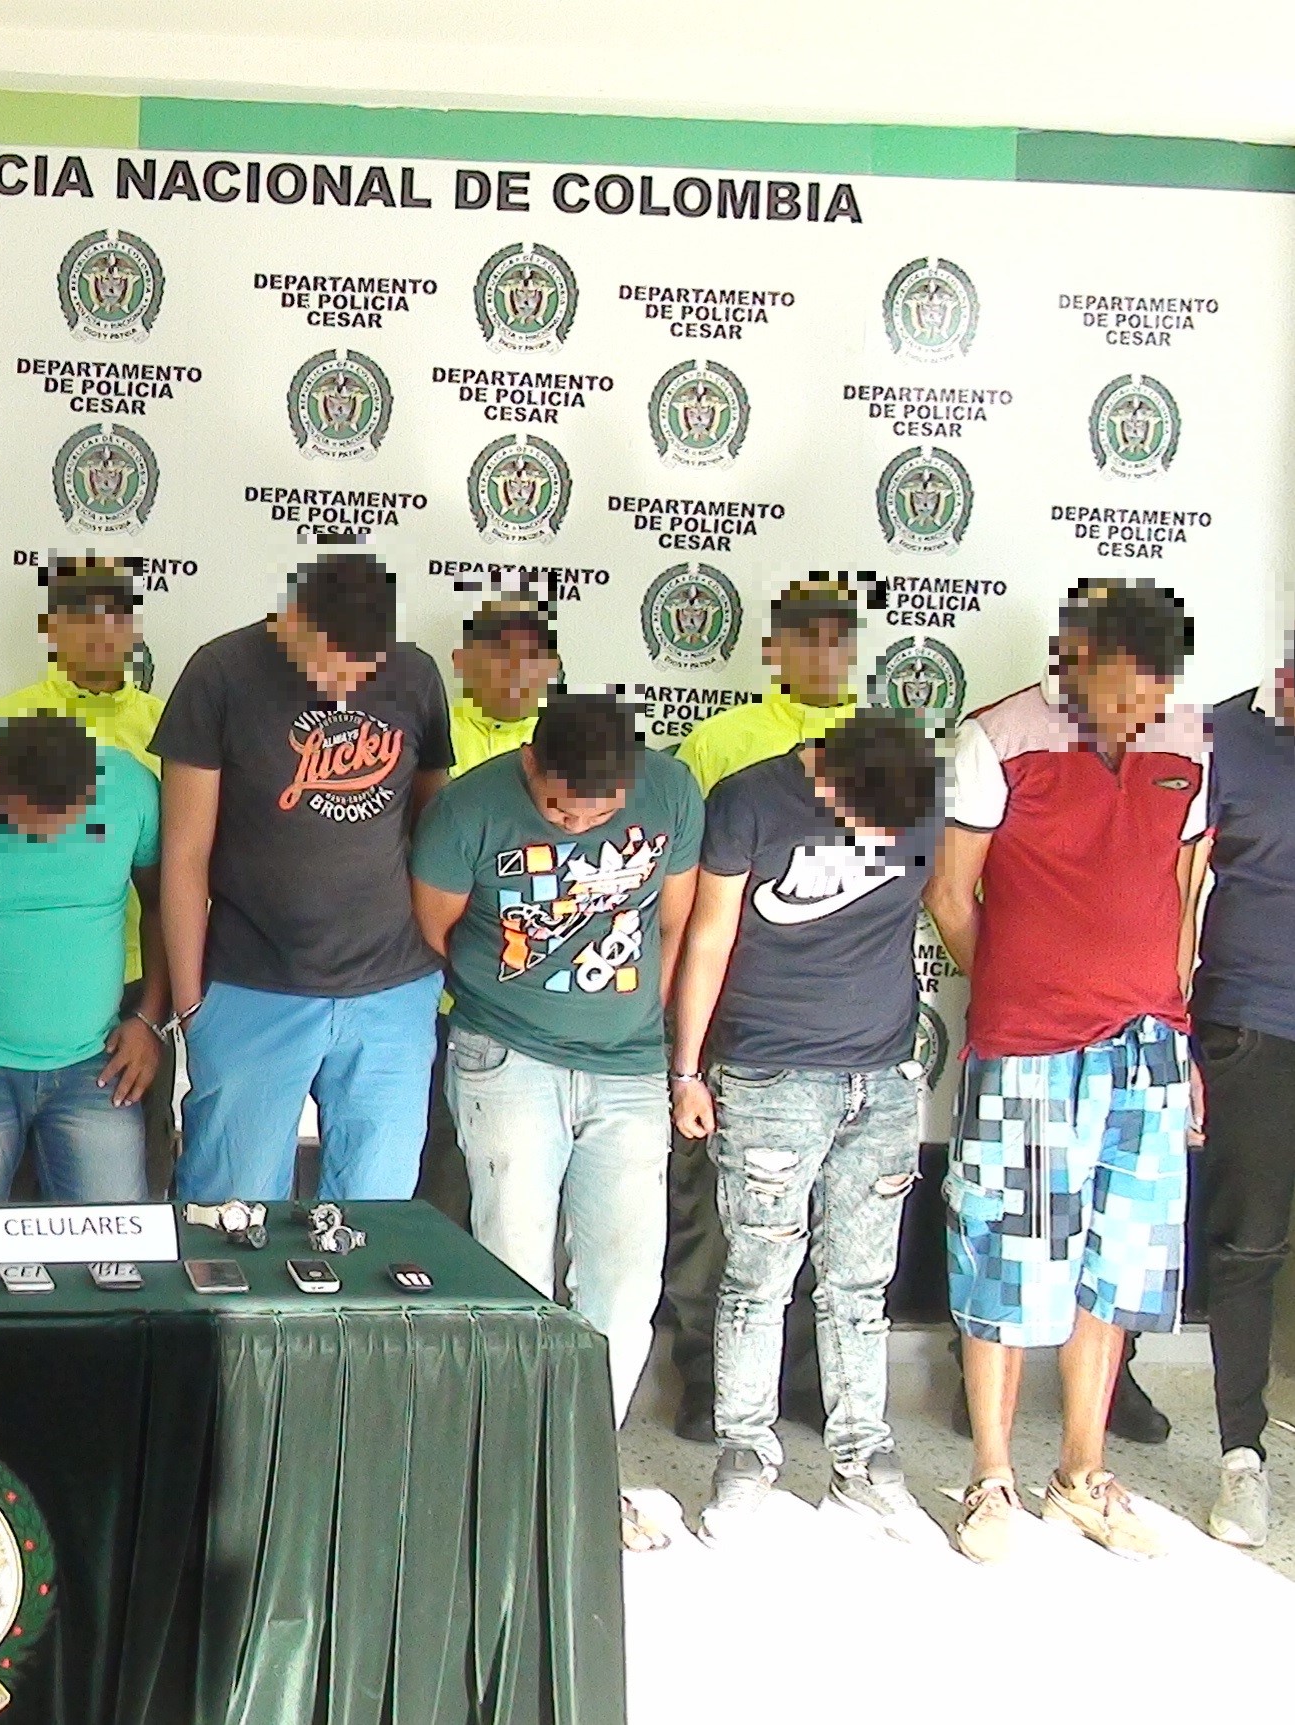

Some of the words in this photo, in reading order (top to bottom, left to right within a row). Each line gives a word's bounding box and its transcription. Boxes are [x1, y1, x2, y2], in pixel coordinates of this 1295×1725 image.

[116, 158, 432, 208] NACIONAL
[455, 169, 530, 212] DE
[553, 173, 862, 224] COLOMBIA
[254, 273, 437, 295] DEPARTAMENTO
[281, 292, 310, 308] DE
[318, 294, 409, 312] POLICIA
[619, 285, 795, 307] DEPARTAMENTO
[1060, 295, 1218, 313] DEPARTAMENTO
[307, 311, 382, 328] CESAR
[646, 304, 672, 320] DE
[681, 306, 768, 323] POLICIA
[1084, 313, 1107, 327] DE
[1116, 314, 1194, 329] POLICIA
[670, 322, 742, 339] CESAR
[1106, 330, 1170, 346] CESAR
[17, 358, 202, 383] DEPARTAMENTO
[432, 367, 613, 391] DEPARTAMENTO
[44, 377, 73, 394] DE
[82, 379, 173, 399] POLICIA
[460, 386, 488, 403] DE
[496, 388, 585, 407] POLICIA
[844, 385, 1012, 404] DEPARTAMENTO
[70, 396, 145, 415] CESAR
[484, 405, 558, 424] CESAR
[869, 403, 895, 418] DE
[904, 405, 986, 421] POLICIA
[893, 421, 961, 437] CESAR
[245, 487, 427, 509] DEPARTAMENTO
[608, 496, 785, 519] DEPARTAMENTO
[271, 505, 300, 522] DE
[308, 507, 399, 526] POLICIA
[634, 515, 662, 531] DE
[670, 517, 757, 535] POLICIA
[1052, 506, 1211, 527] DEPARTAMENTO
[659, 533, 731, 552] CESAR
[1075, 524, 1099, 539] DE
[1108, 526, 1186, 542] POLICIA
[1098, 542, 1162, 558] CESAR
[898, 594, 981, 611] POLICIA
[886, 610, 955, 628] CESAR
[278, 718, 404, 812] Lucky
[308, 785, 396, 823] BROOKLYN
[4, 1217, 143, 1236] CELULARES
